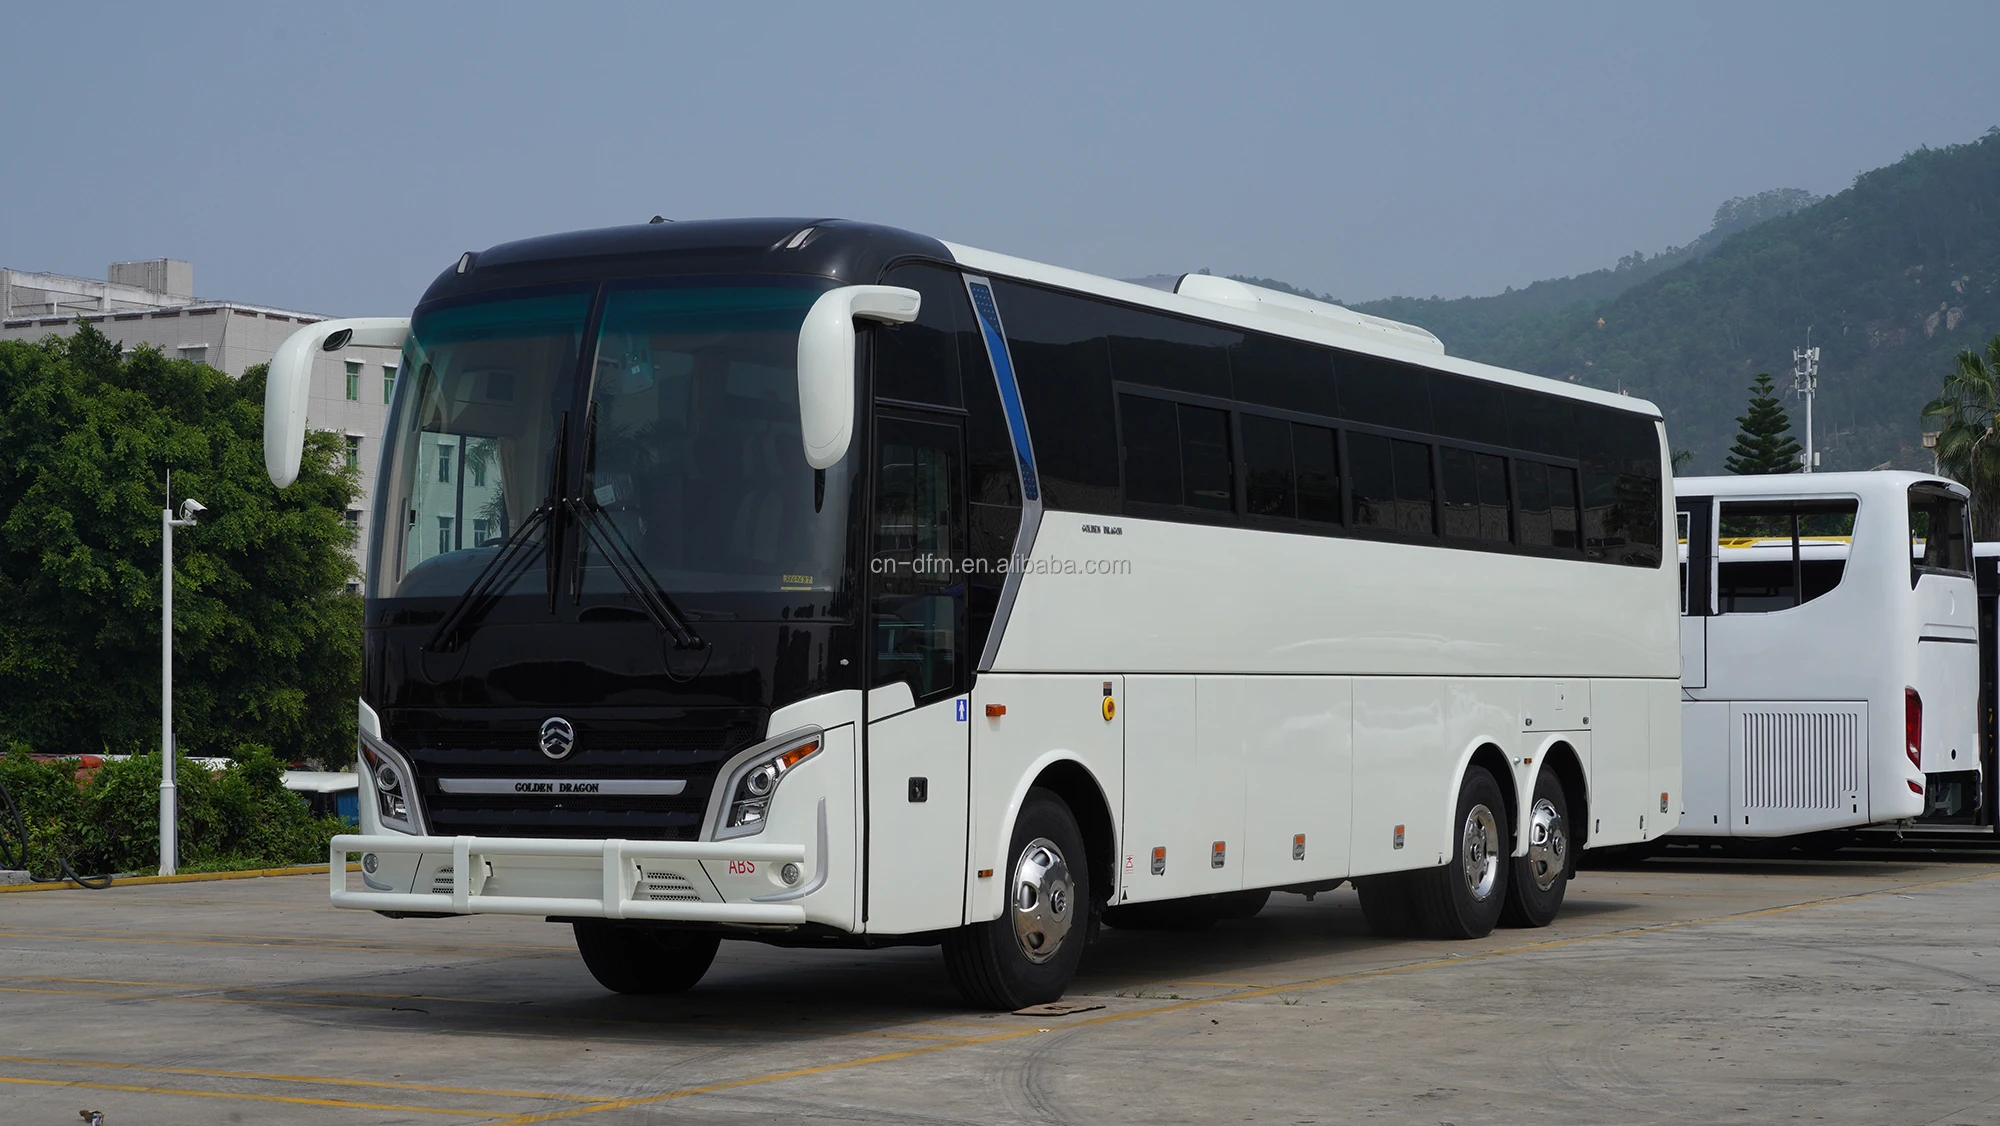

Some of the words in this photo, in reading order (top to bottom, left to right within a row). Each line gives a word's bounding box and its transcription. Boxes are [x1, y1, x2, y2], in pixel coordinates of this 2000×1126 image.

[514, 782, 554, 793] GOLDEN
[559, 782, 600, 793] DRAGON
[728, 860, 756, 875] ABS
